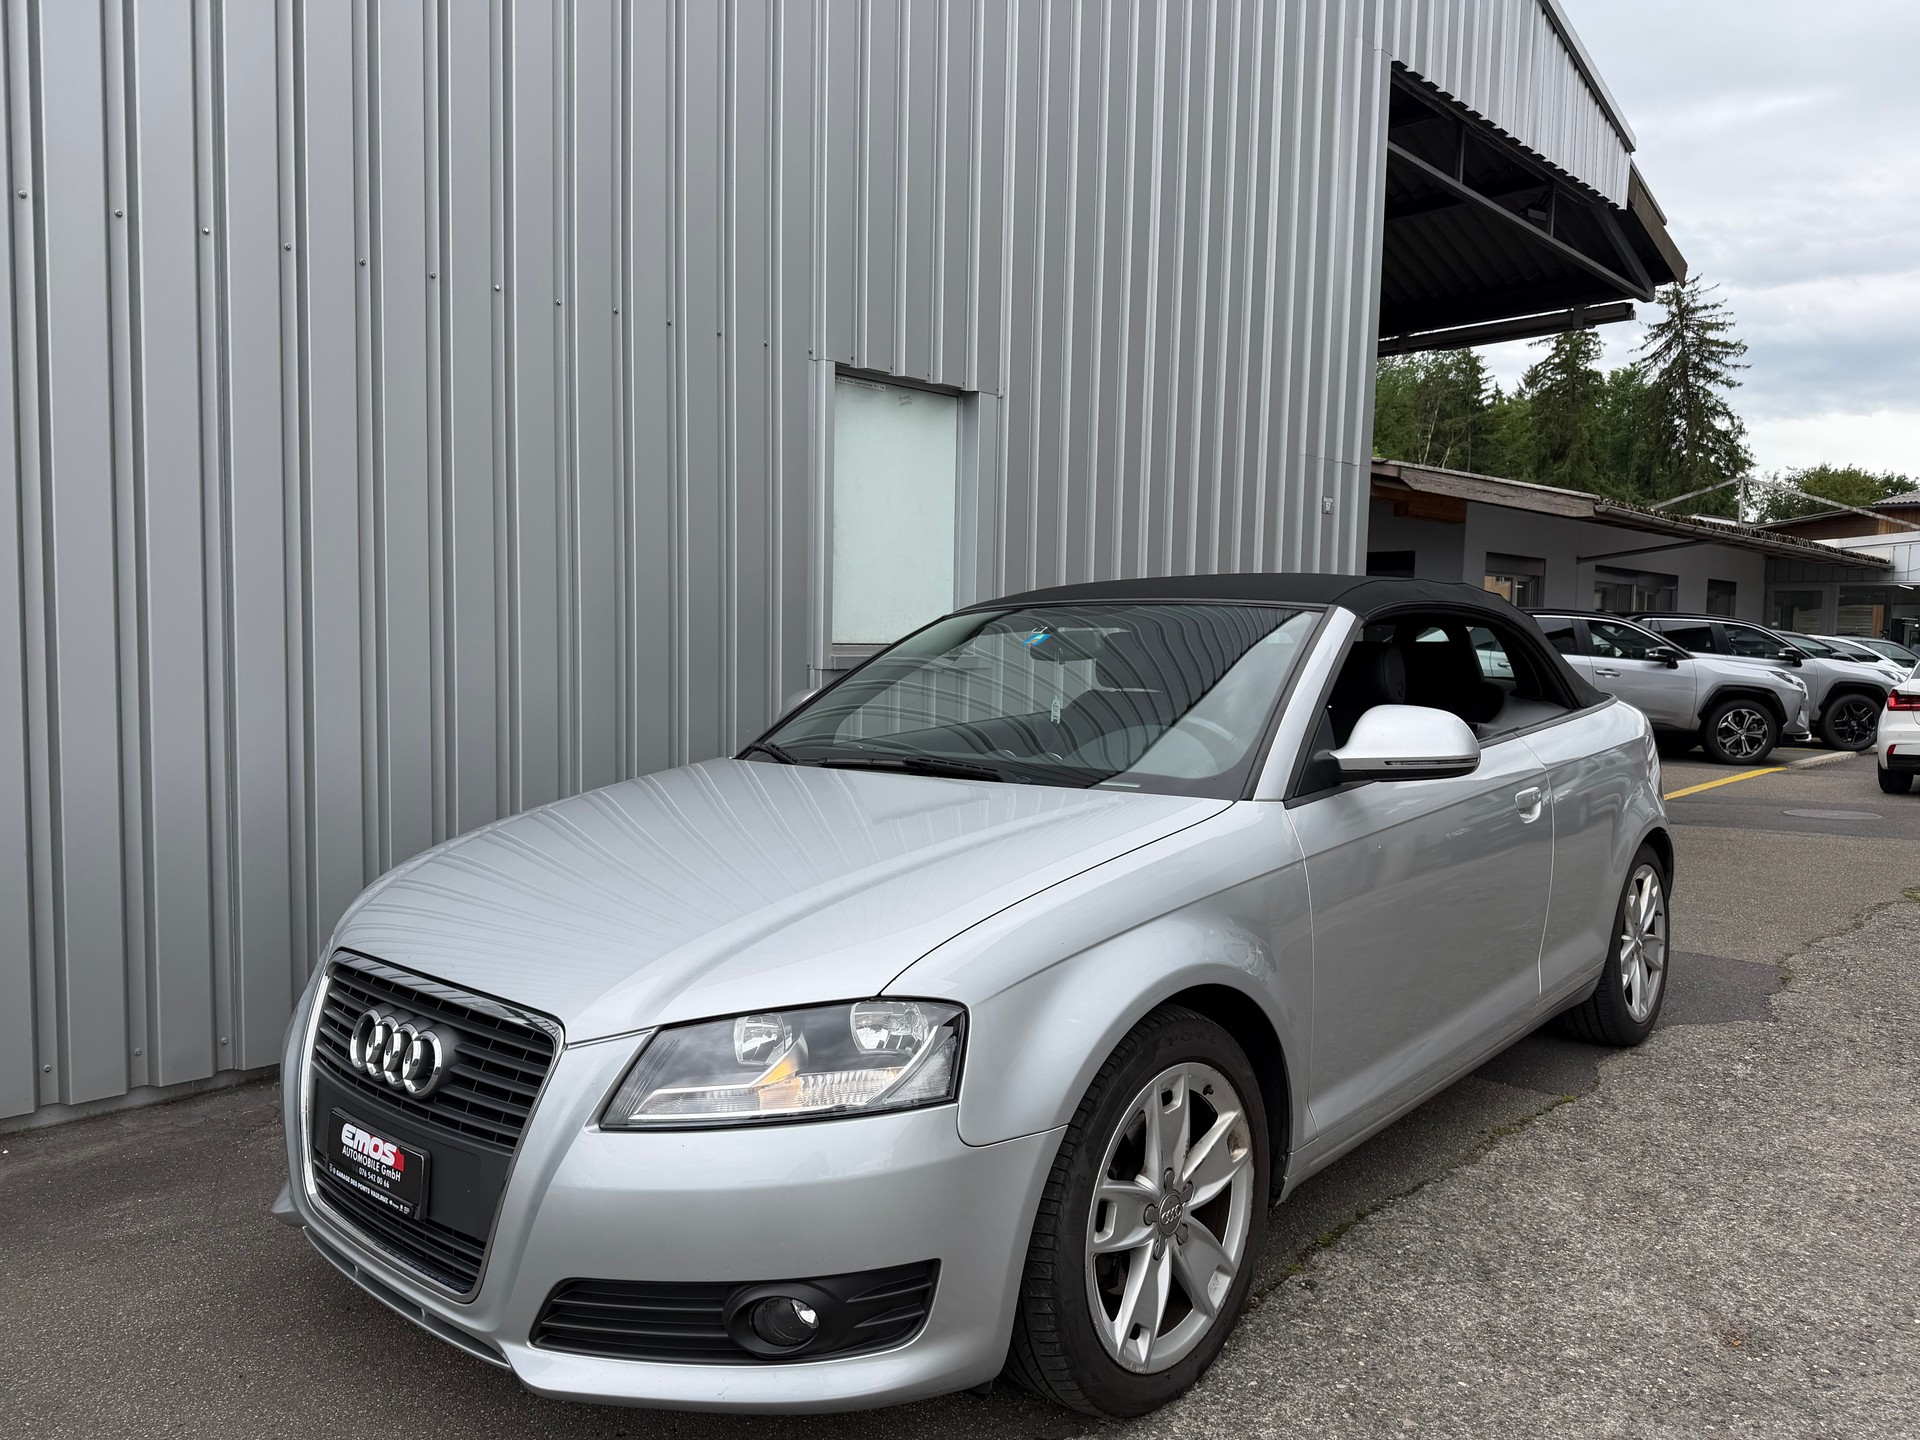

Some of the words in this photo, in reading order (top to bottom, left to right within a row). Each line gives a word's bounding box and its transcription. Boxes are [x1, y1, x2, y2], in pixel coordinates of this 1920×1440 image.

[341, 1123, 397, 1166] EMOS
[342, 1145, 380, 1172] AUTOMOBILE
[381, 1165, 401, 1182] GmbH
[359, 1167, 367, 1178] 076
